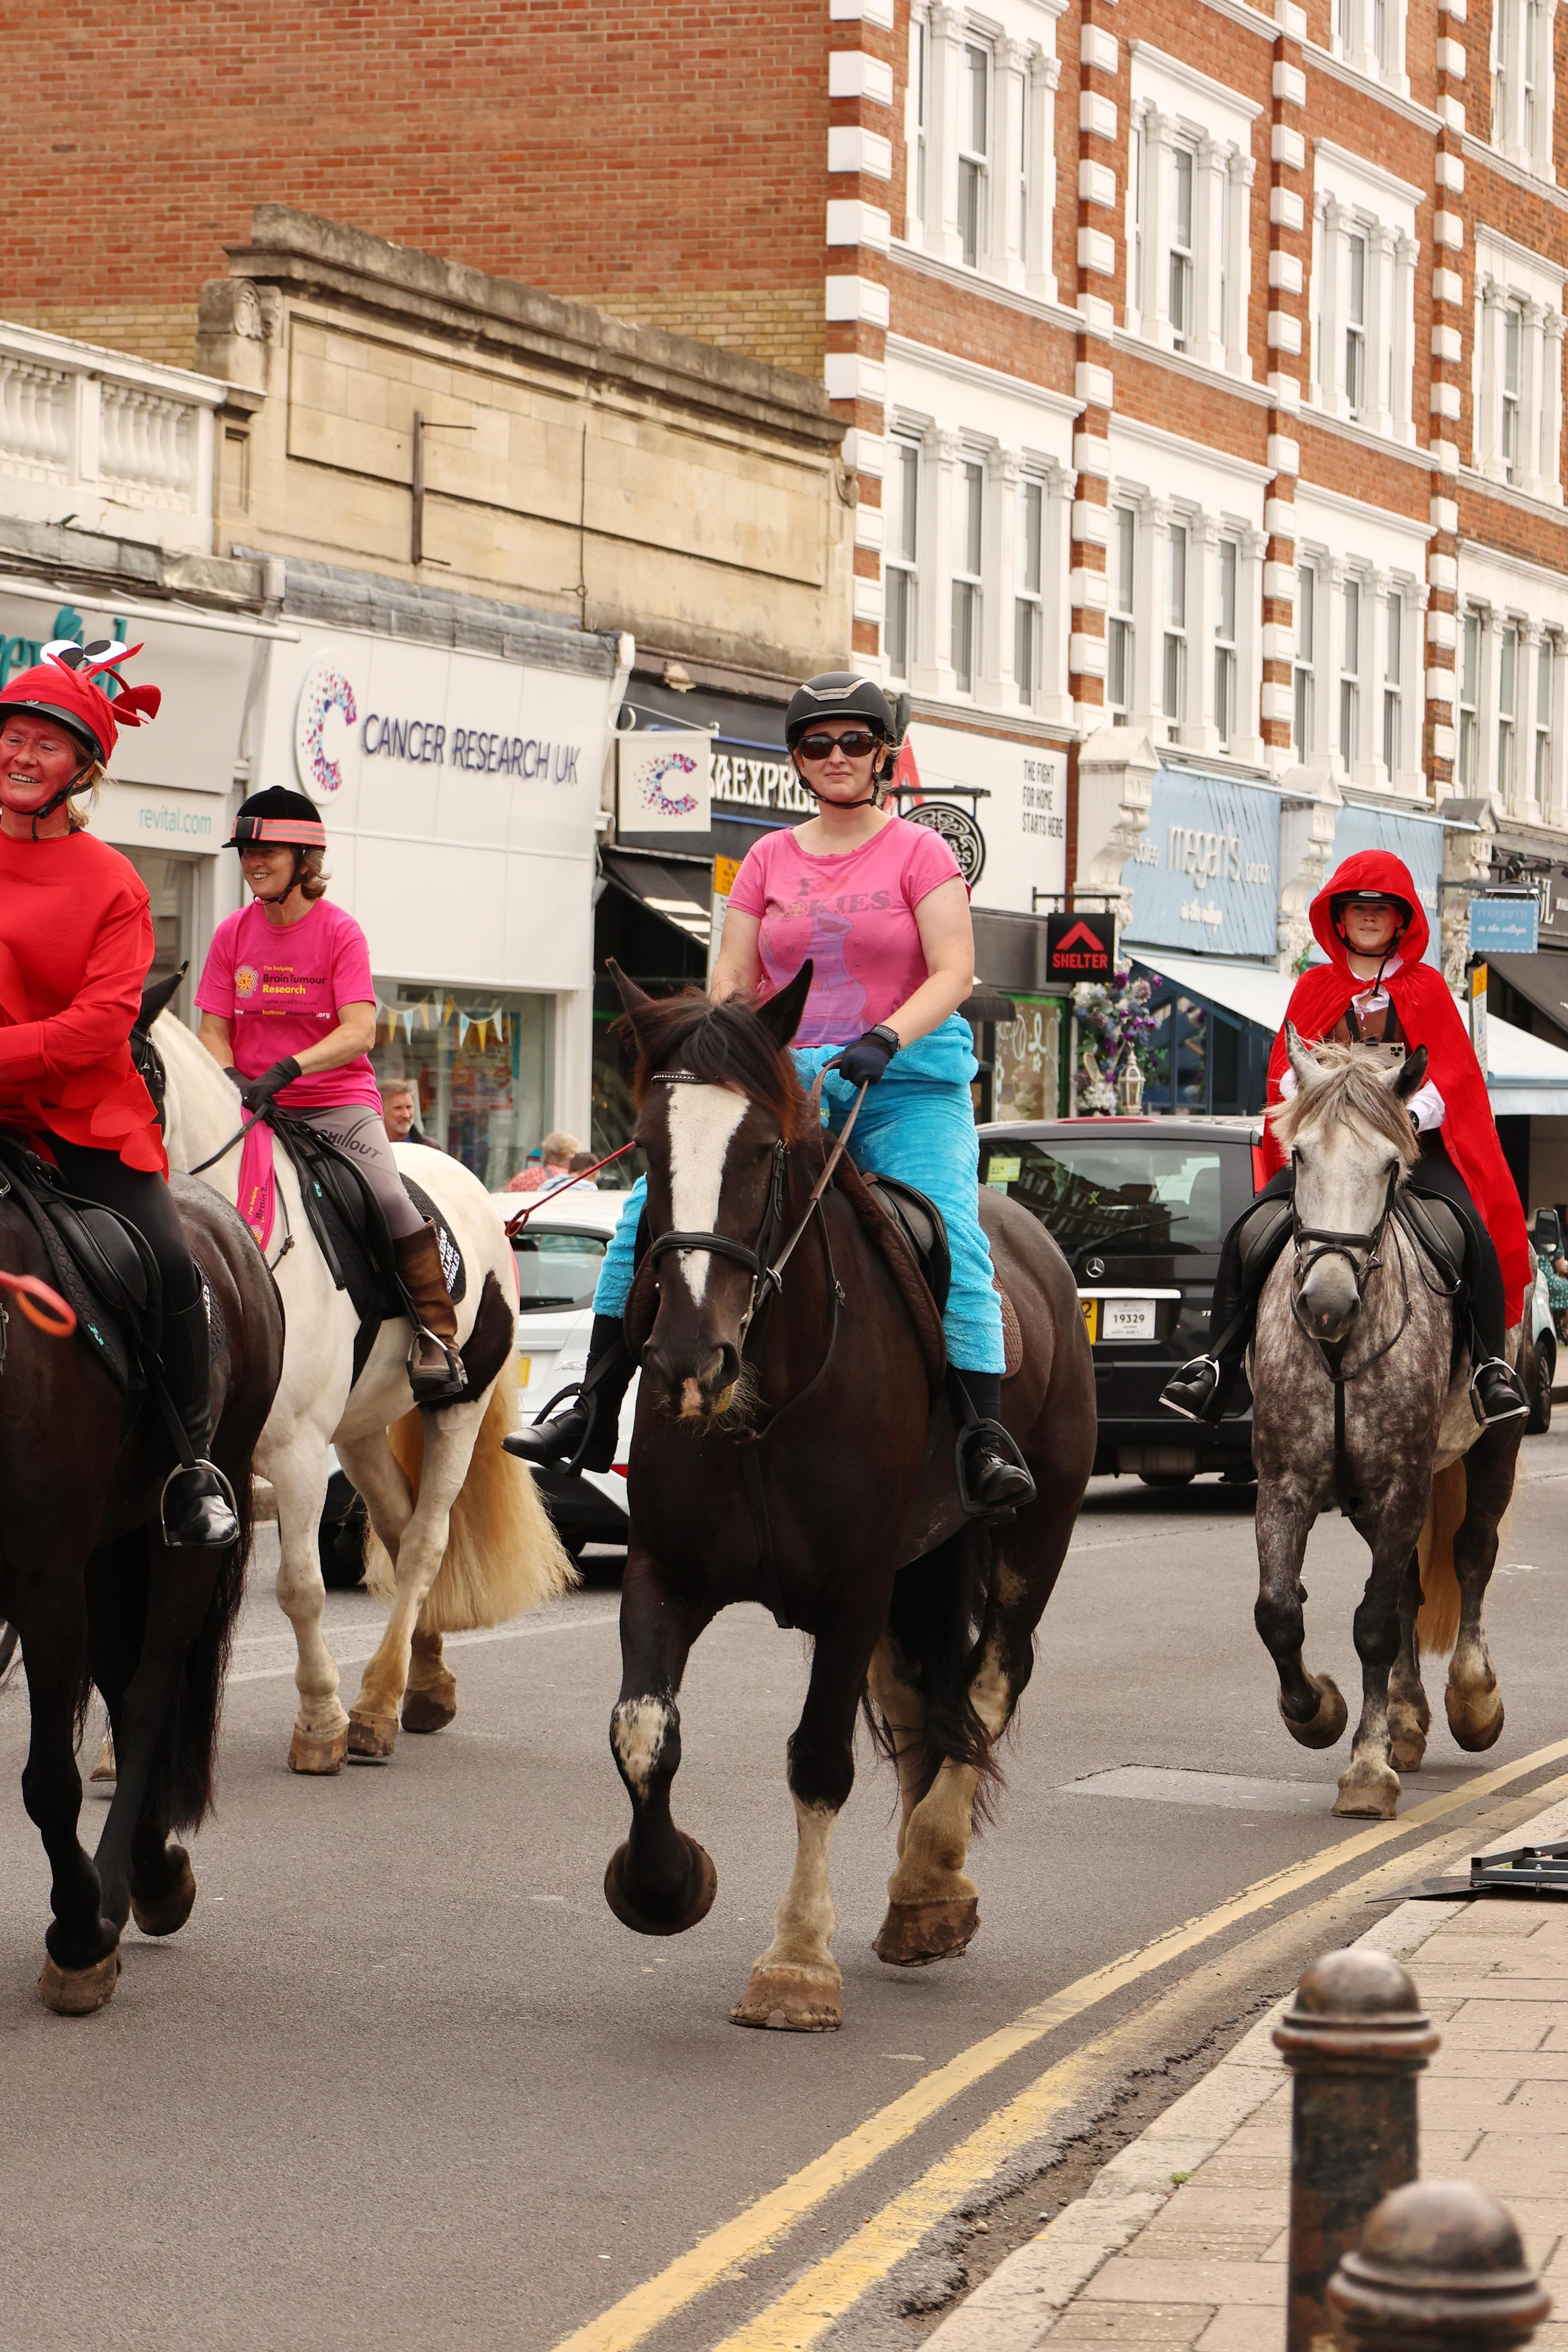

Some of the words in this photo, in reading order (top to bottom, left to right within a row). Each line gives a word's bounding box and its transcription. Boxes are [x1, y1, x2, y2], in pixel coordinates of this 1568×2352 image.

[364, 714, 445, 764] CANCER
[453, 728, 551, 780] RESEARCH
[556, 744, 581, 784] UK
[1024, 760, 1036, 782] THE
[1038, 763, 1054, 785] FIGHT
[1023, 786, 1035, 808] FOR
[1037, 788, 1052, 811] HOME
[139, 805, 211, 835] revital.com
[1022, 812, 1046, 835] STARTS
[1048, 816, 1063, 839] HERE
[1167, 824, 1240, 890] megan's
[797, 878, 813, 896] I
[1052, 953, 1108, 968] SHELTER
[262, 984, 306, 994] Research
[263, 974, 288, 984] Brain
[290, 974, 326, 984] Tumour
[251, 1185, 259, 1206] helping
[255, 1193, 266, 1219] Brain
[1114, 1314, 1145, 1324] 19329
